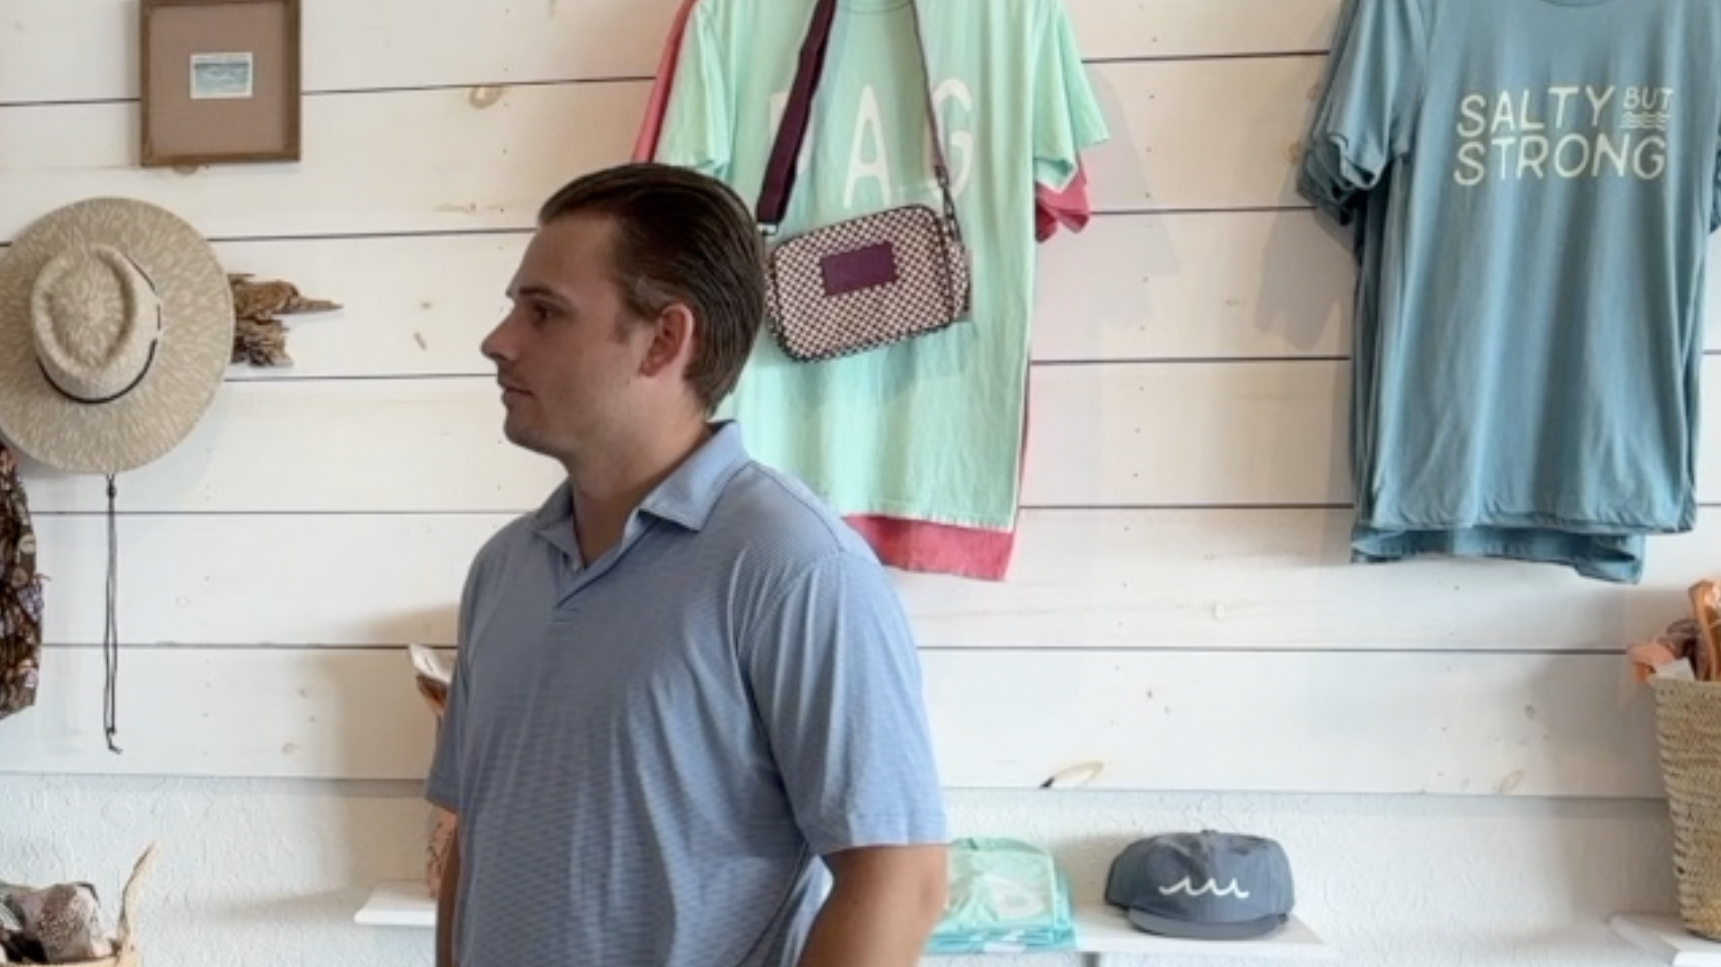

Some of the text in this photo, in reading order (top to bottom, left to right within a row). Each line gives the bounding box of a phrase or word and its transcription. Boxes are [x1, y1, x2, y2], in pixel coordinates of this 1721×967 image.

[1456, 85, 1675, 138] SALTY BUT
[1453, 133, 1667, 186] STRONG
